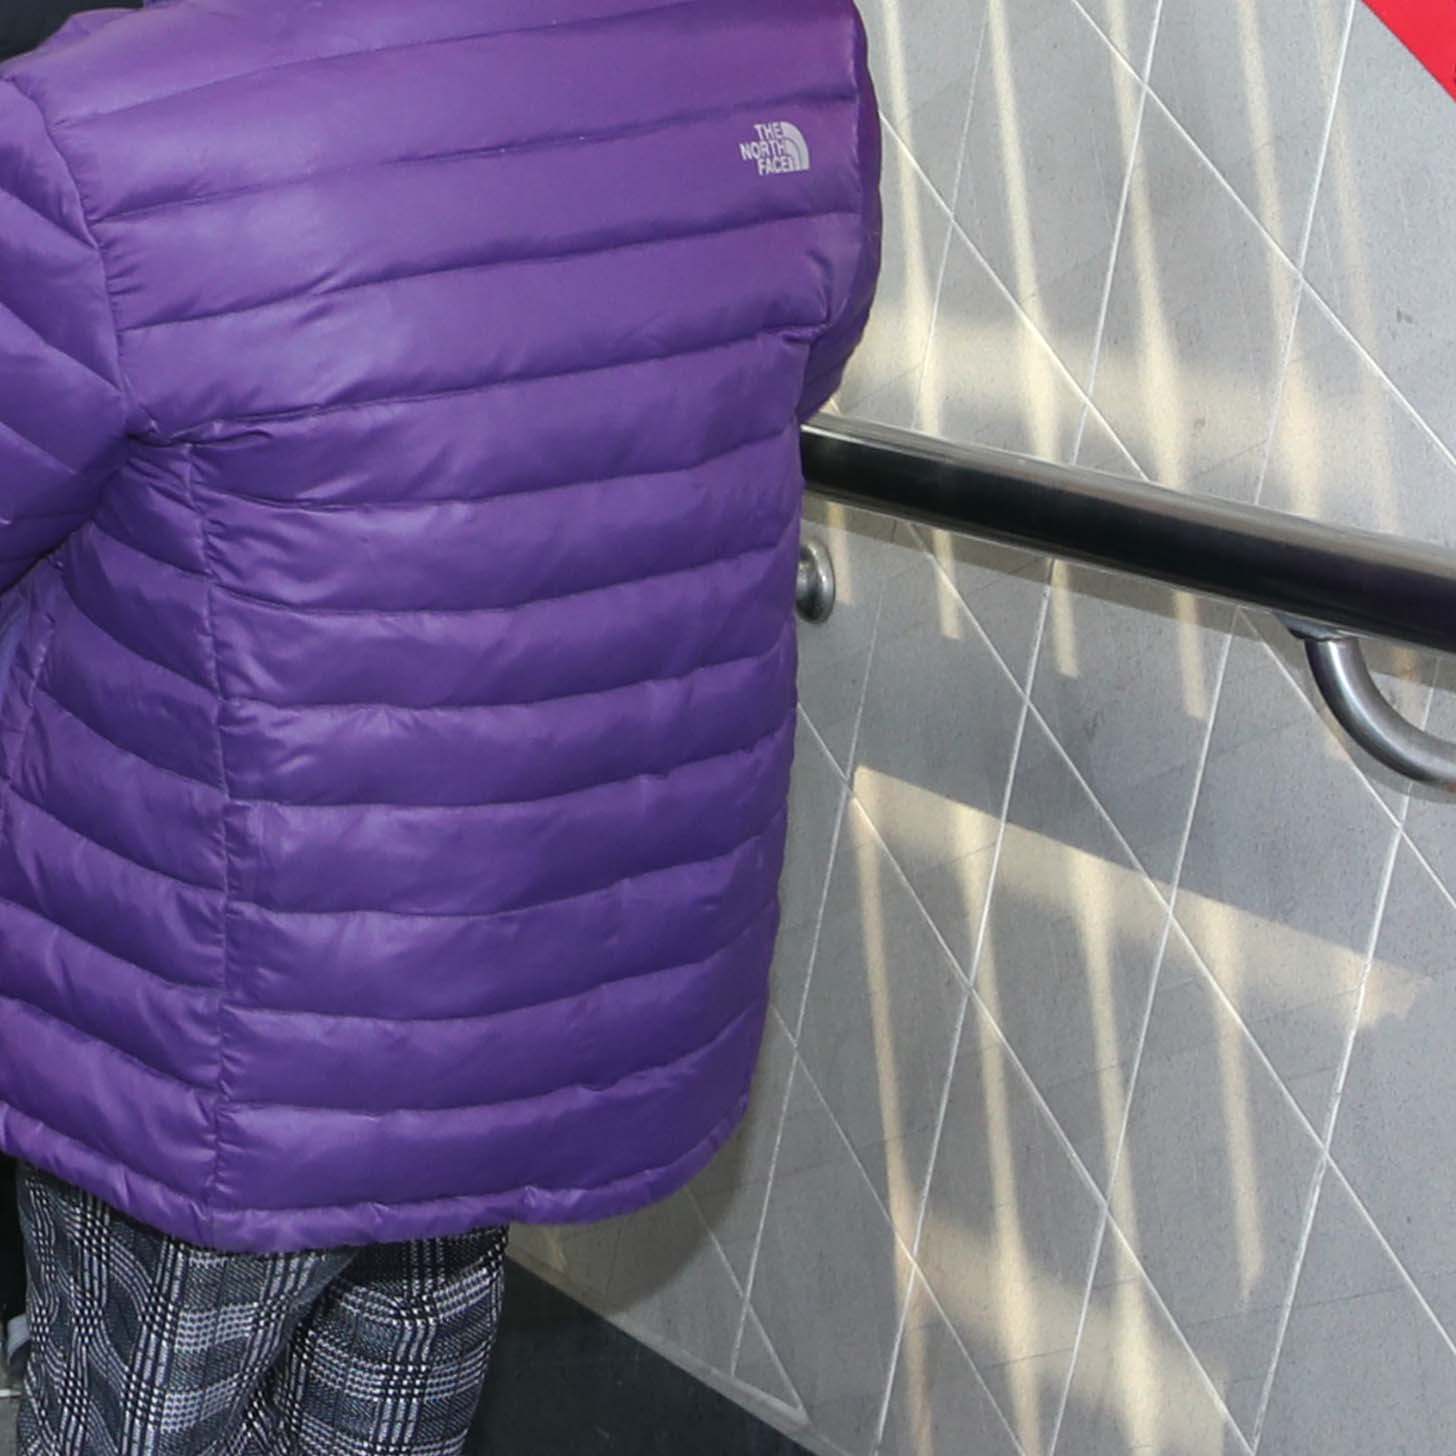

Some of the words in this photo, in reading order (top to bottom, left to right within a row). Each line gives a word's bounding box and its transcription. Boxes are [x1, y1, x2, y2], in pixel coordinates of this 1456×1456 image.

[753, 121, 785, 141] THE
[738, 138, 786, 161] NORTH
[757, 155, 790, 176] FACE
